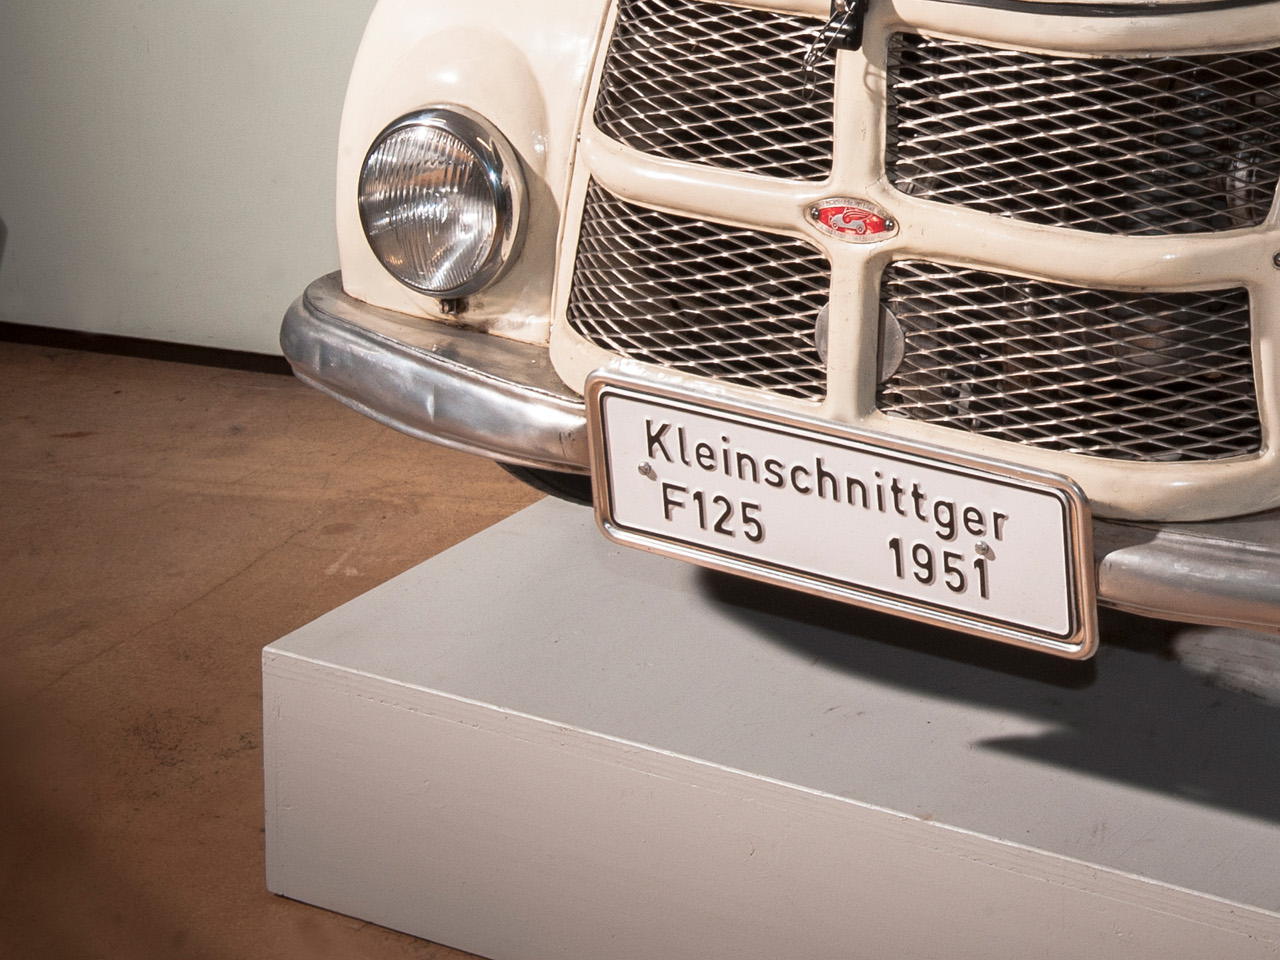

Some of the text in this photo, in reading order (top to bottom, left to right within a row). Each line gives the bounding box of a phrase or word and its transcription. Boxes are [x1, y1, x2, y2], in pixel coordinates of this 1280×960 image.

[645, 419, 1008, 541] Kleinschnittger
[662, 482, 990, 599] F125 1951
